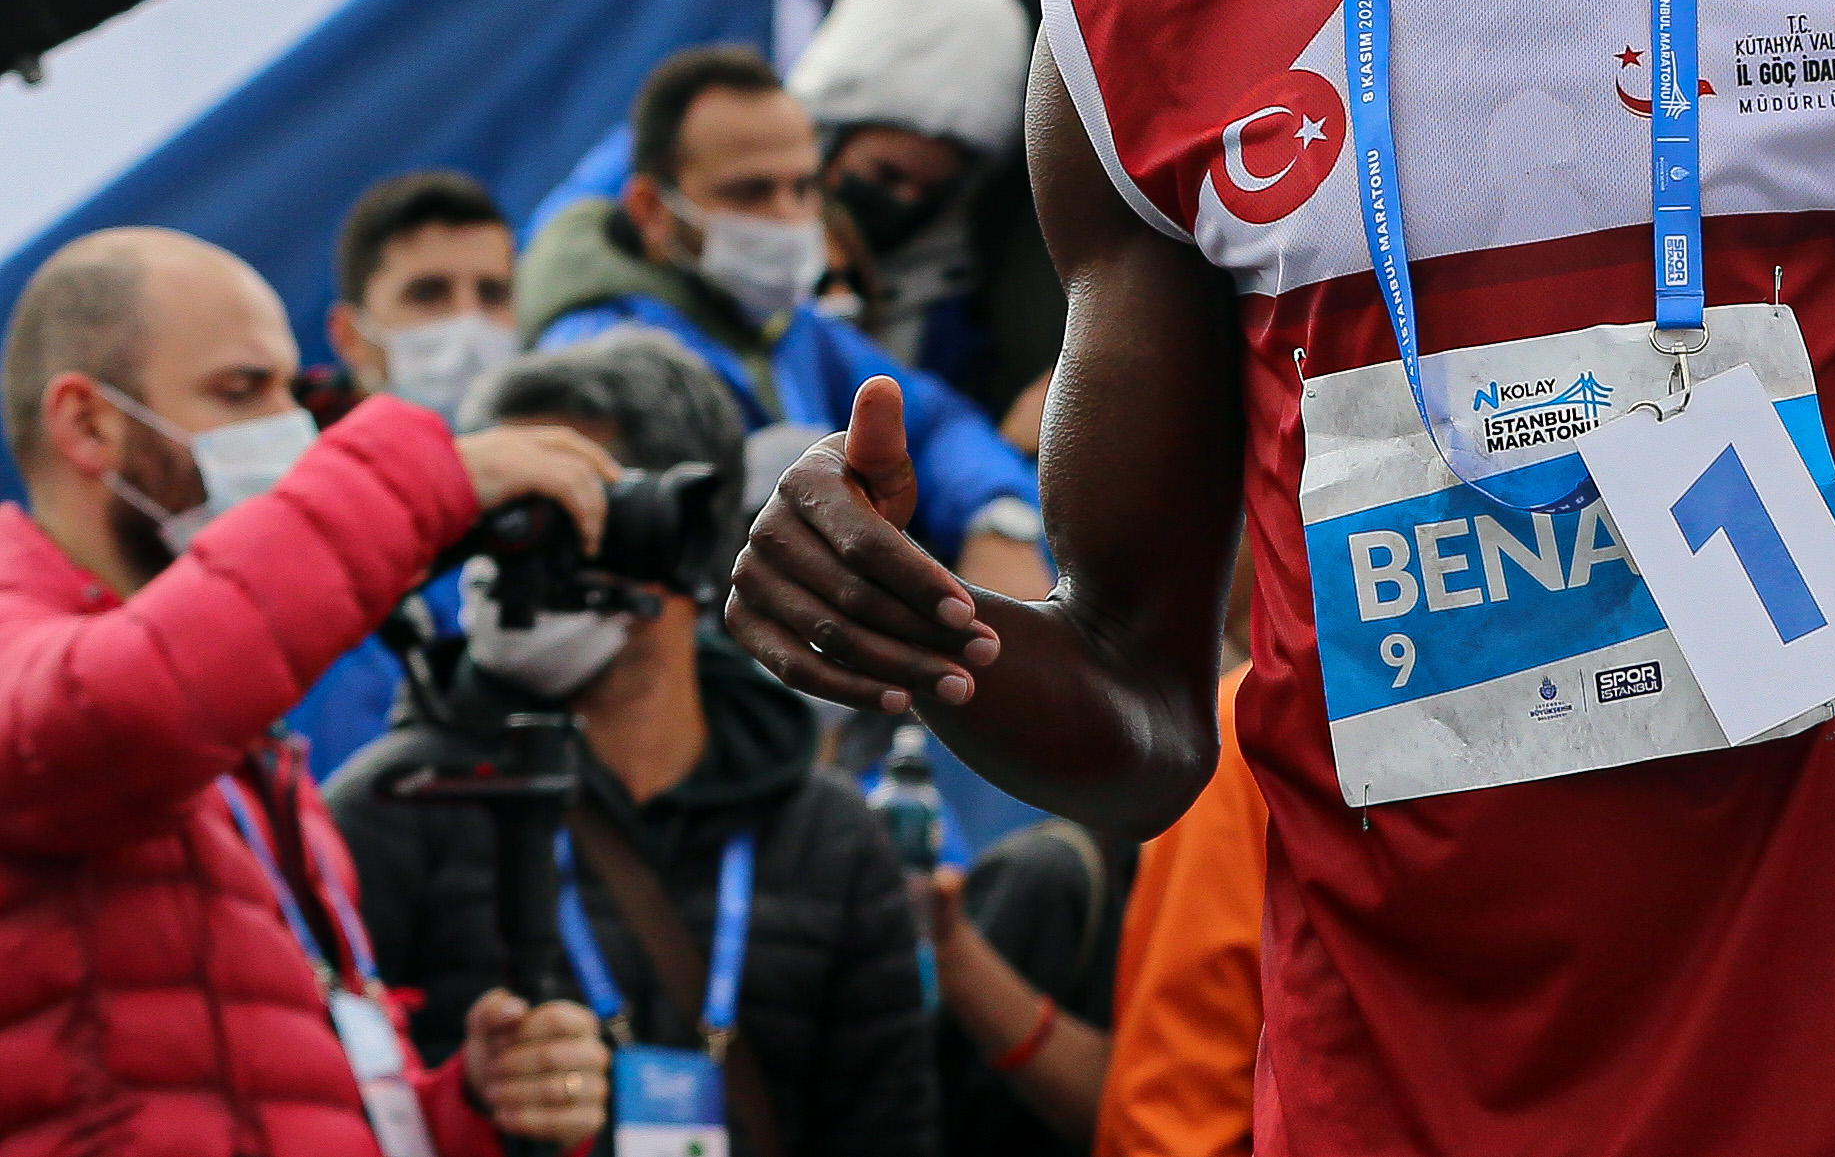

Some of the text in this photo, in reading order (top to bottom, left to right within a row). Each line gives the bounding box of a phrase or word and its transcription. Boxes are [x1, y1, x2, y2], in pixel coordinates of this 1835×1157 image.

[1786, 14, 1812, 34] T.C.
[1359, 32, 1374, 88] KASIM
[1735, 33, 1804, 56] KÜTAHYA
[1736, 57, 1753, 87] İL
[1759, 55, 1797, 88] GÖÇ
[1362, 90, 1375, 103] 8
[1367, 148, 1392, 253] MARATONU
[1673, 238, 1686, 282] SPOR
[1500, 378, 1556, 402] KOLAY
[1484, 407, 1584, 437] İSTANBUL
[1347, 496, 1641, 622] BENA
[1669, 441, 1829, 646] 1
[1378, 632, 1418, 690] 9
[1600, 665, 1657, 690] SPOR
